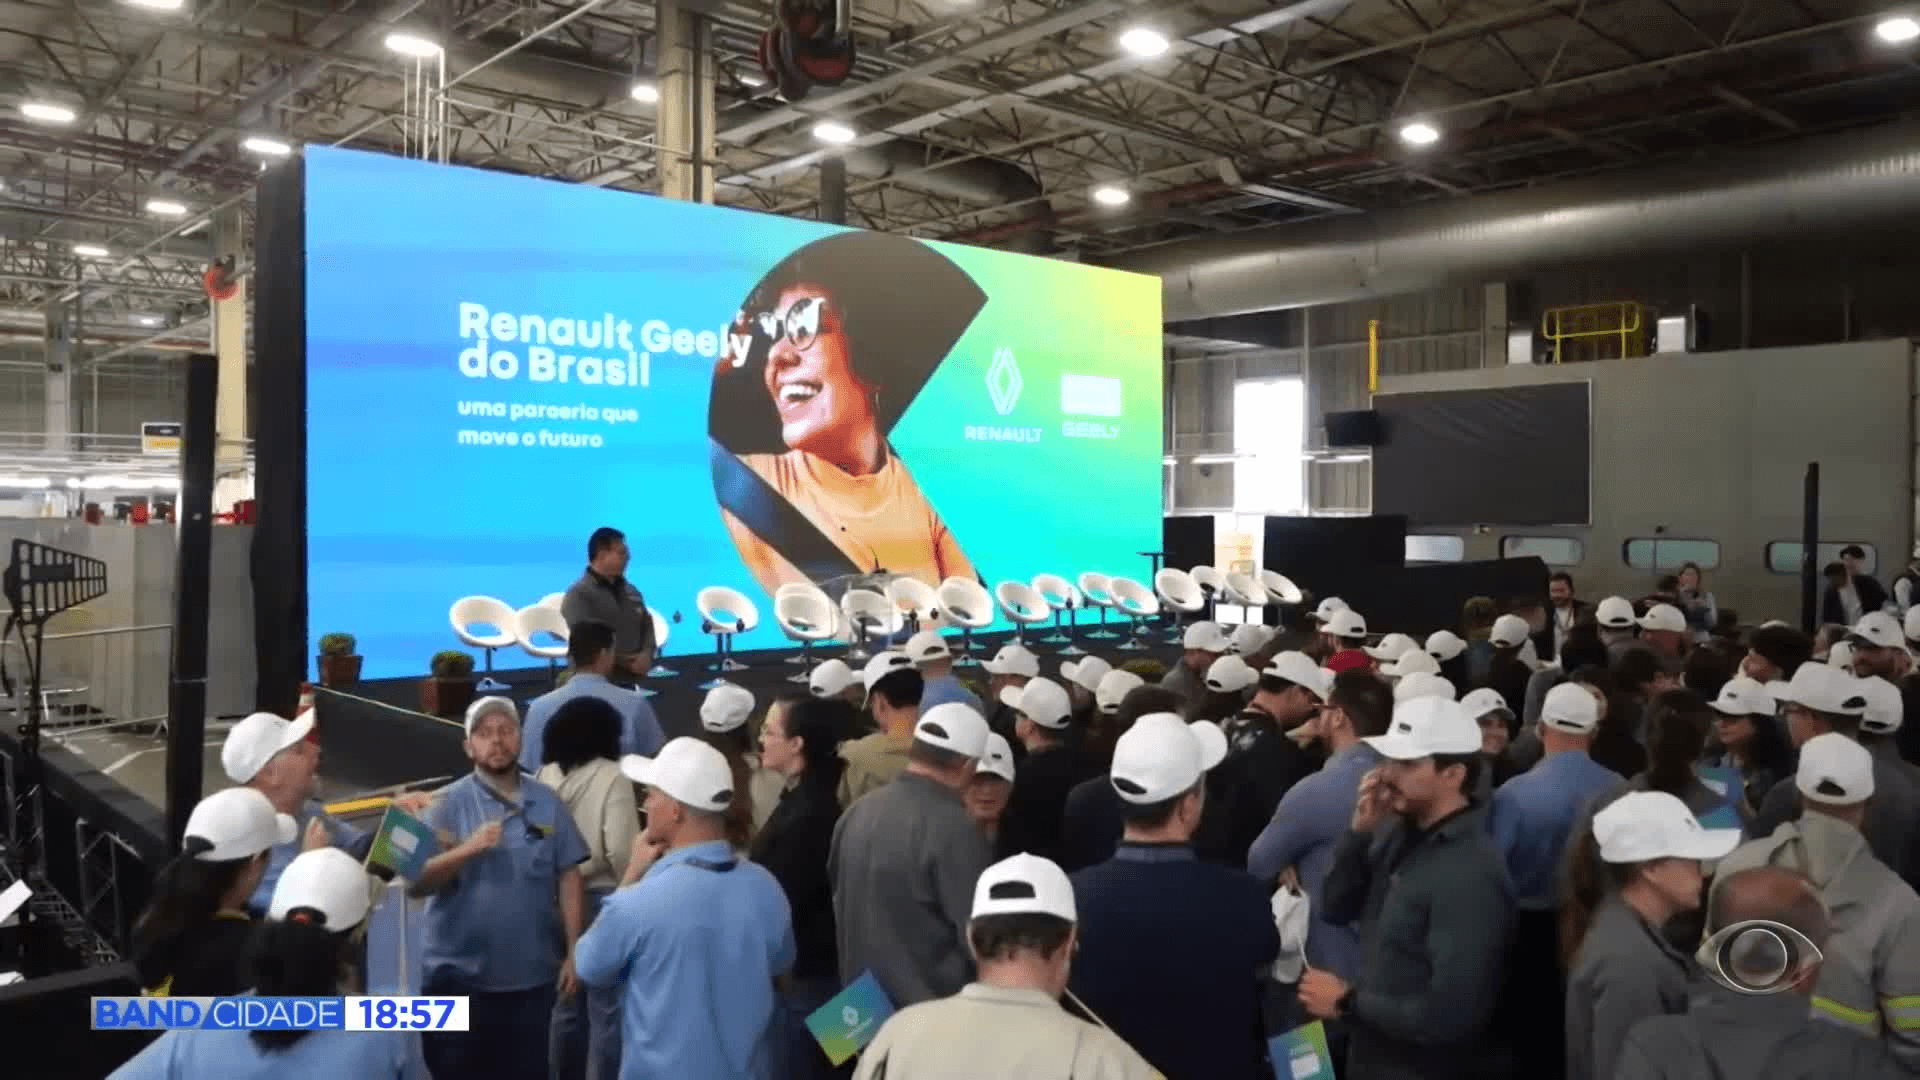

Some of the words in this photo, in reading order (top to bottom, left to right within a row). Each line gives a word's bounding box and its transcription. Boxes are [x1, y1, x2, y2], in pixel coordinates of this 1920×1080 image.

[458, 301, 634, 350] Renault
[640, 318, 752, 368] Geely
[458, 339, 519, 379] do
[528, 345, 650, 387] Brasil
[457, 400, 506, 416] uma
[510, 402, 599, 421] parceria
[602, 407, 639, 424] que
[457, 429, 518, 446] move
[521, 432, 536, 447] o
[538, 429, 604, 448] futuro
[964, 424, 1043, 443] RENAULT
